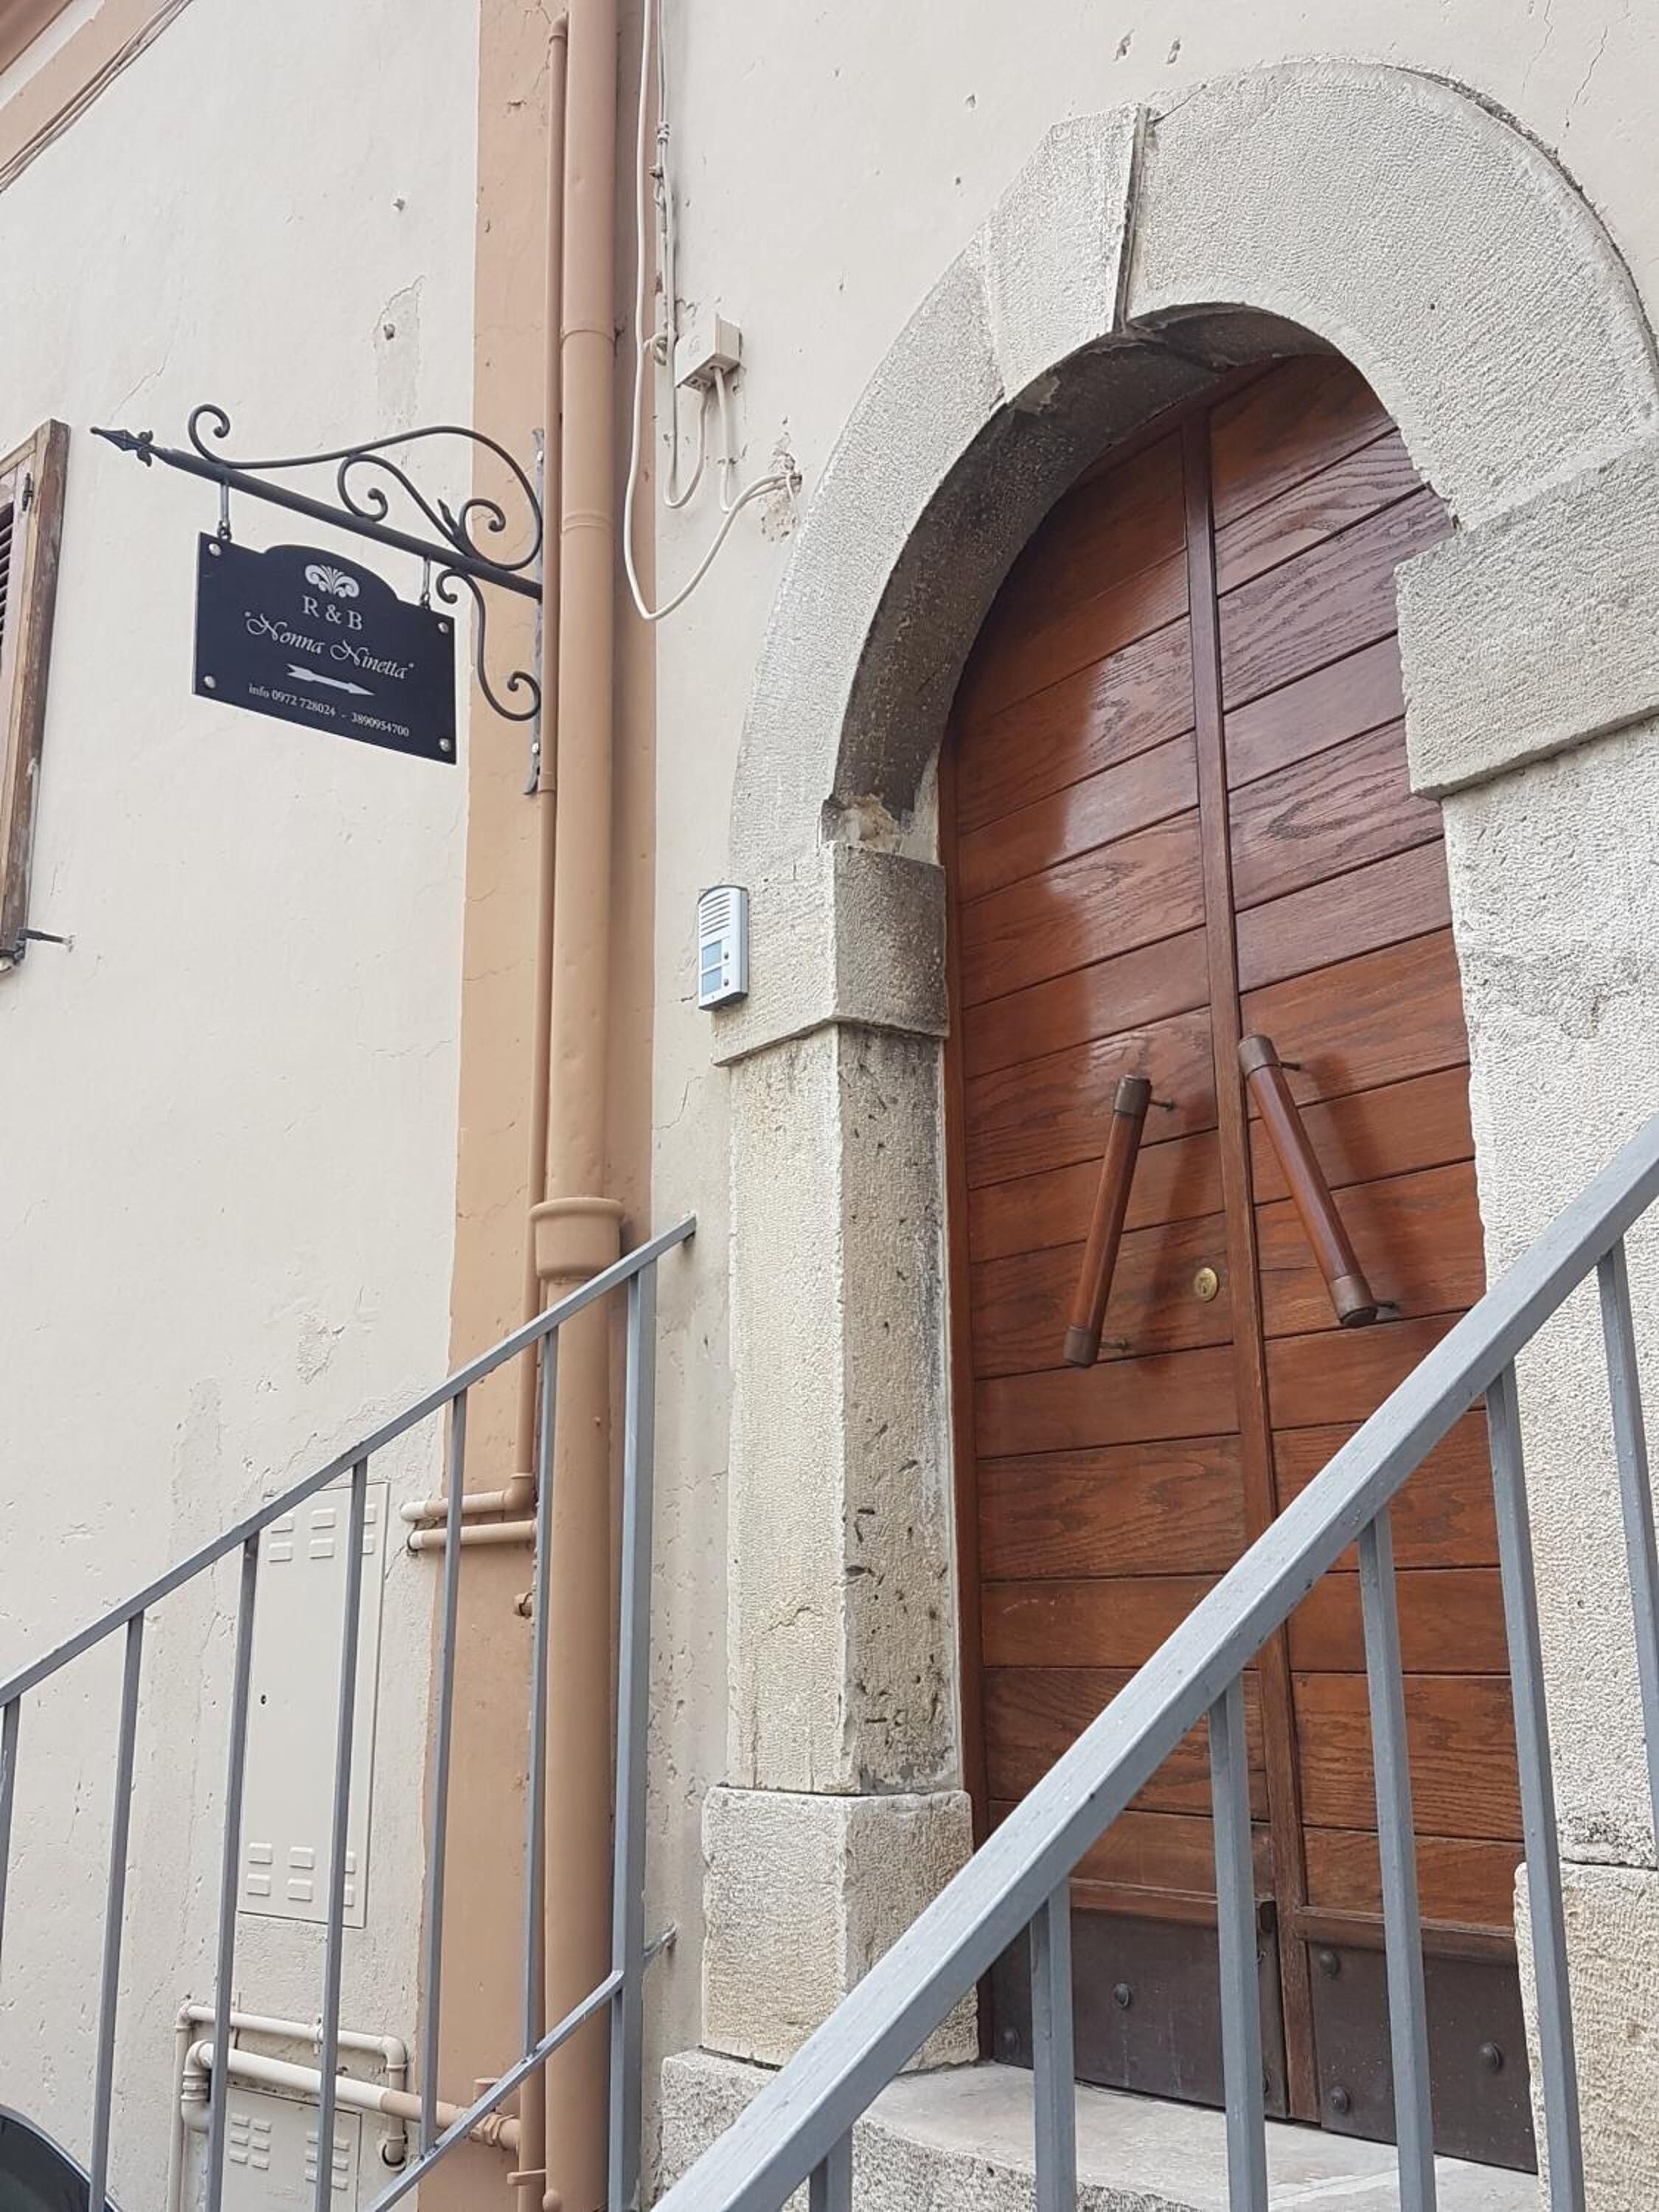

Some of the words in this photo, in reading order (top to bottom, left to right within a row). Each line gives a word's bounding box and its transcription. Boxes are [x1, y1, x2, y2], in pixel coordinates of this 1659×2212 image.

[303, 596, 319, 617] R
[325, 605, 342, 624] &
[348, 611, 363, 630] B
[248, 683, 269, 698] info
[271, 689, 297, 706] 0972
[299, 697, 335, 716] 728024
